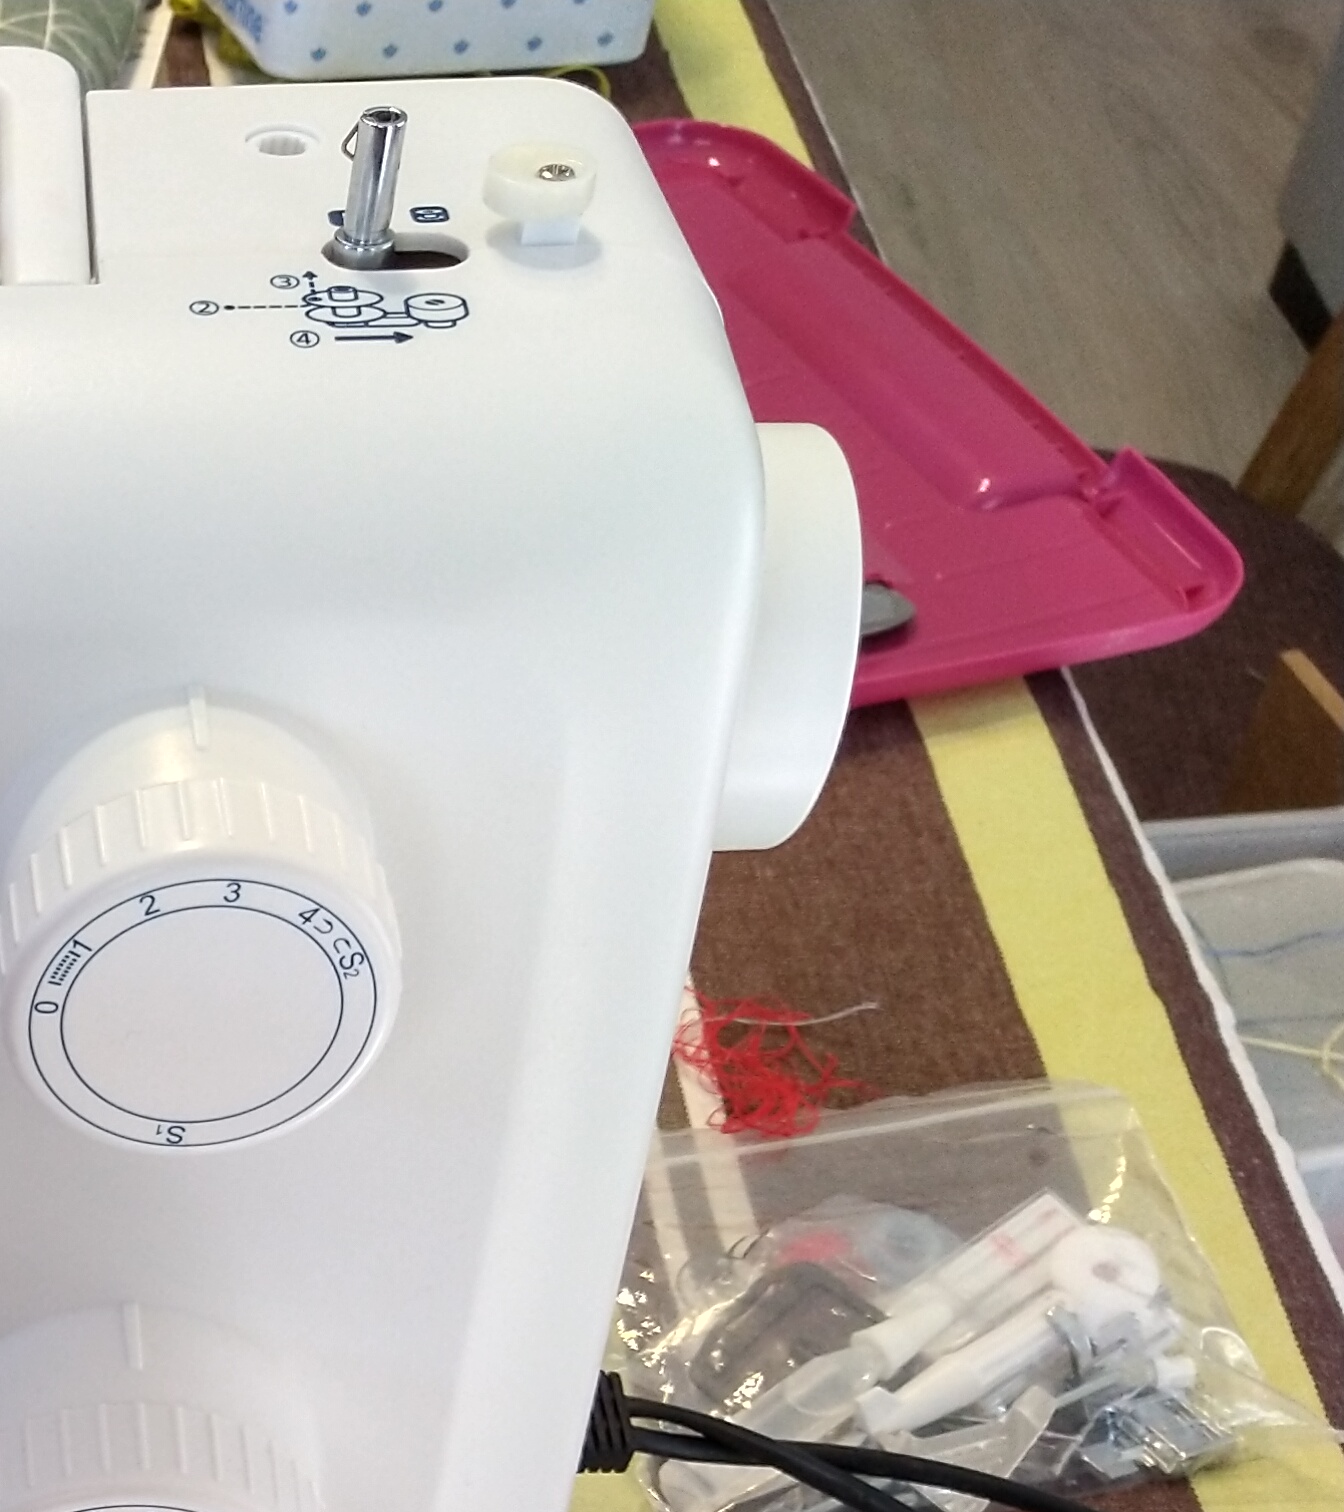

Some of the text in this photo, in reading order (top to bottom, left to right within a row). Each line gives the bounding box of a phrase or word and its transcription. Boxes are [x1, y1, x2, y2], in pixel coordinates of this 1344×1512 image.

[73, 939, 93, 952] 1
[139, 894, 161, 916] 2
[223, 882, 242, 903] 3
[298, 908, 320, 925] 4
